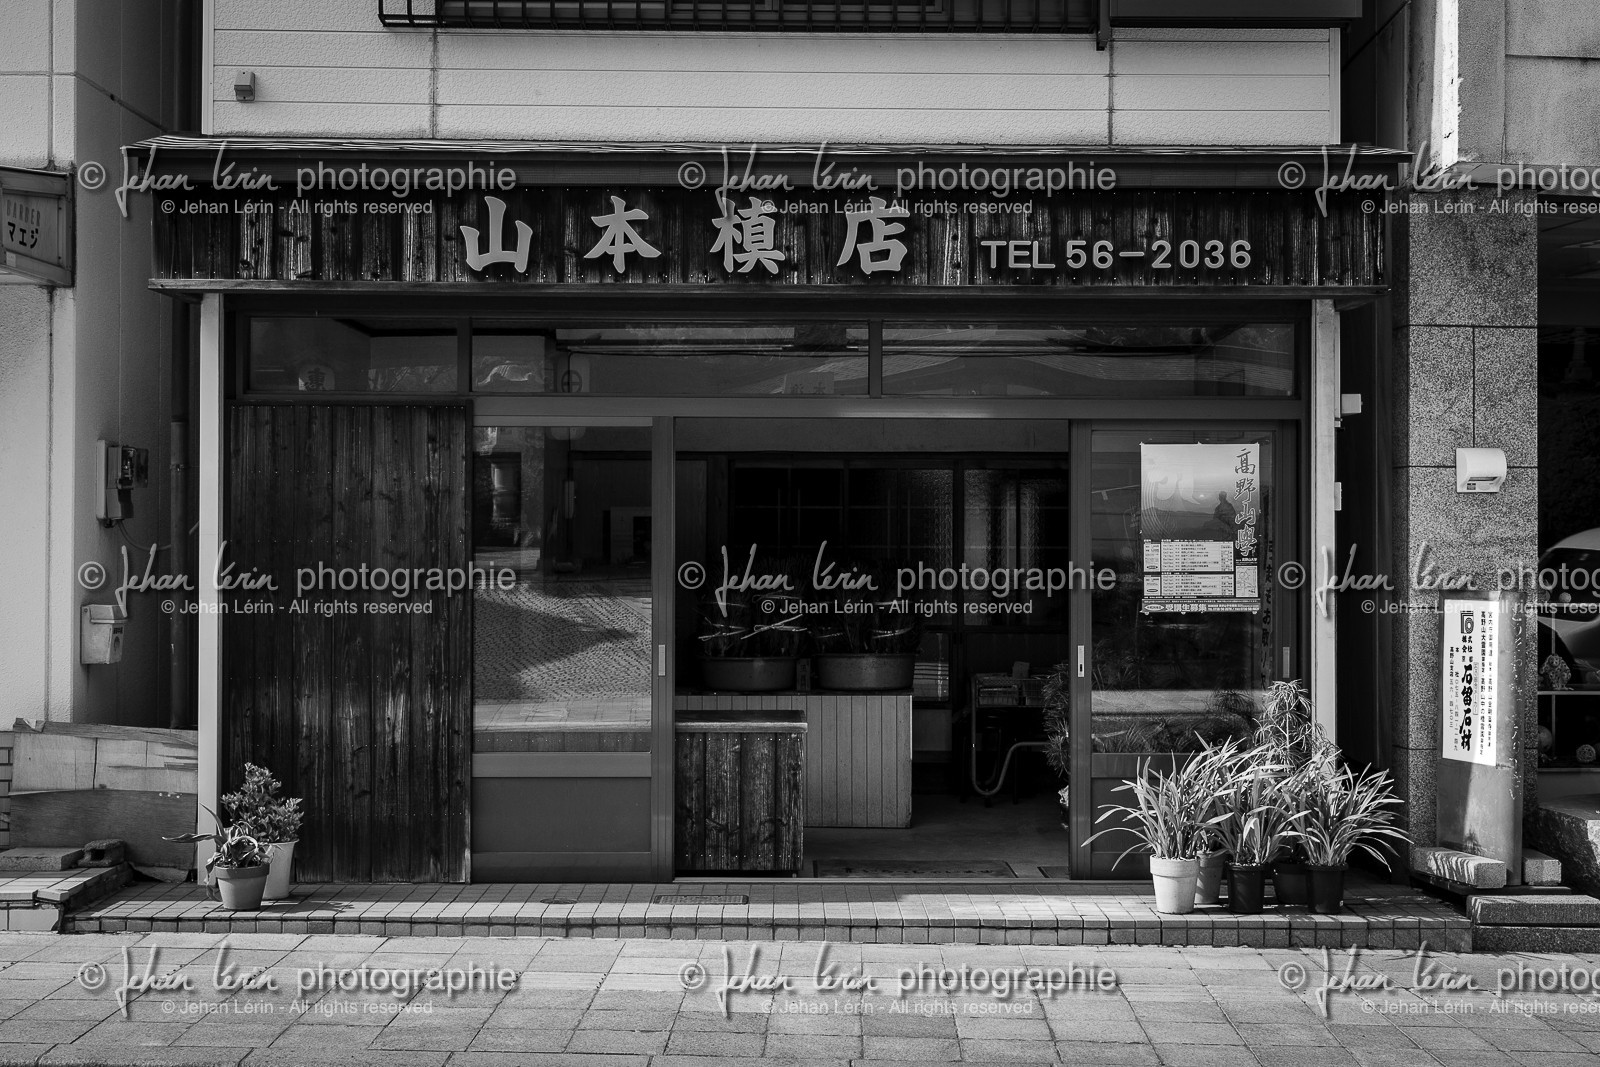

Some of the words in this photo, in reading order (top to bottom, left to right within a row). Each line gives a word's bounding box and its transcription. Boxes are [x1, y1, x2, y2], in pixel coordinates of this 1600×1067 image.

[7, 221, 39, 249] マエジ
[980, 240, 1056, 269] TEL
[1066, 240, 1252, 269] 56-2036
